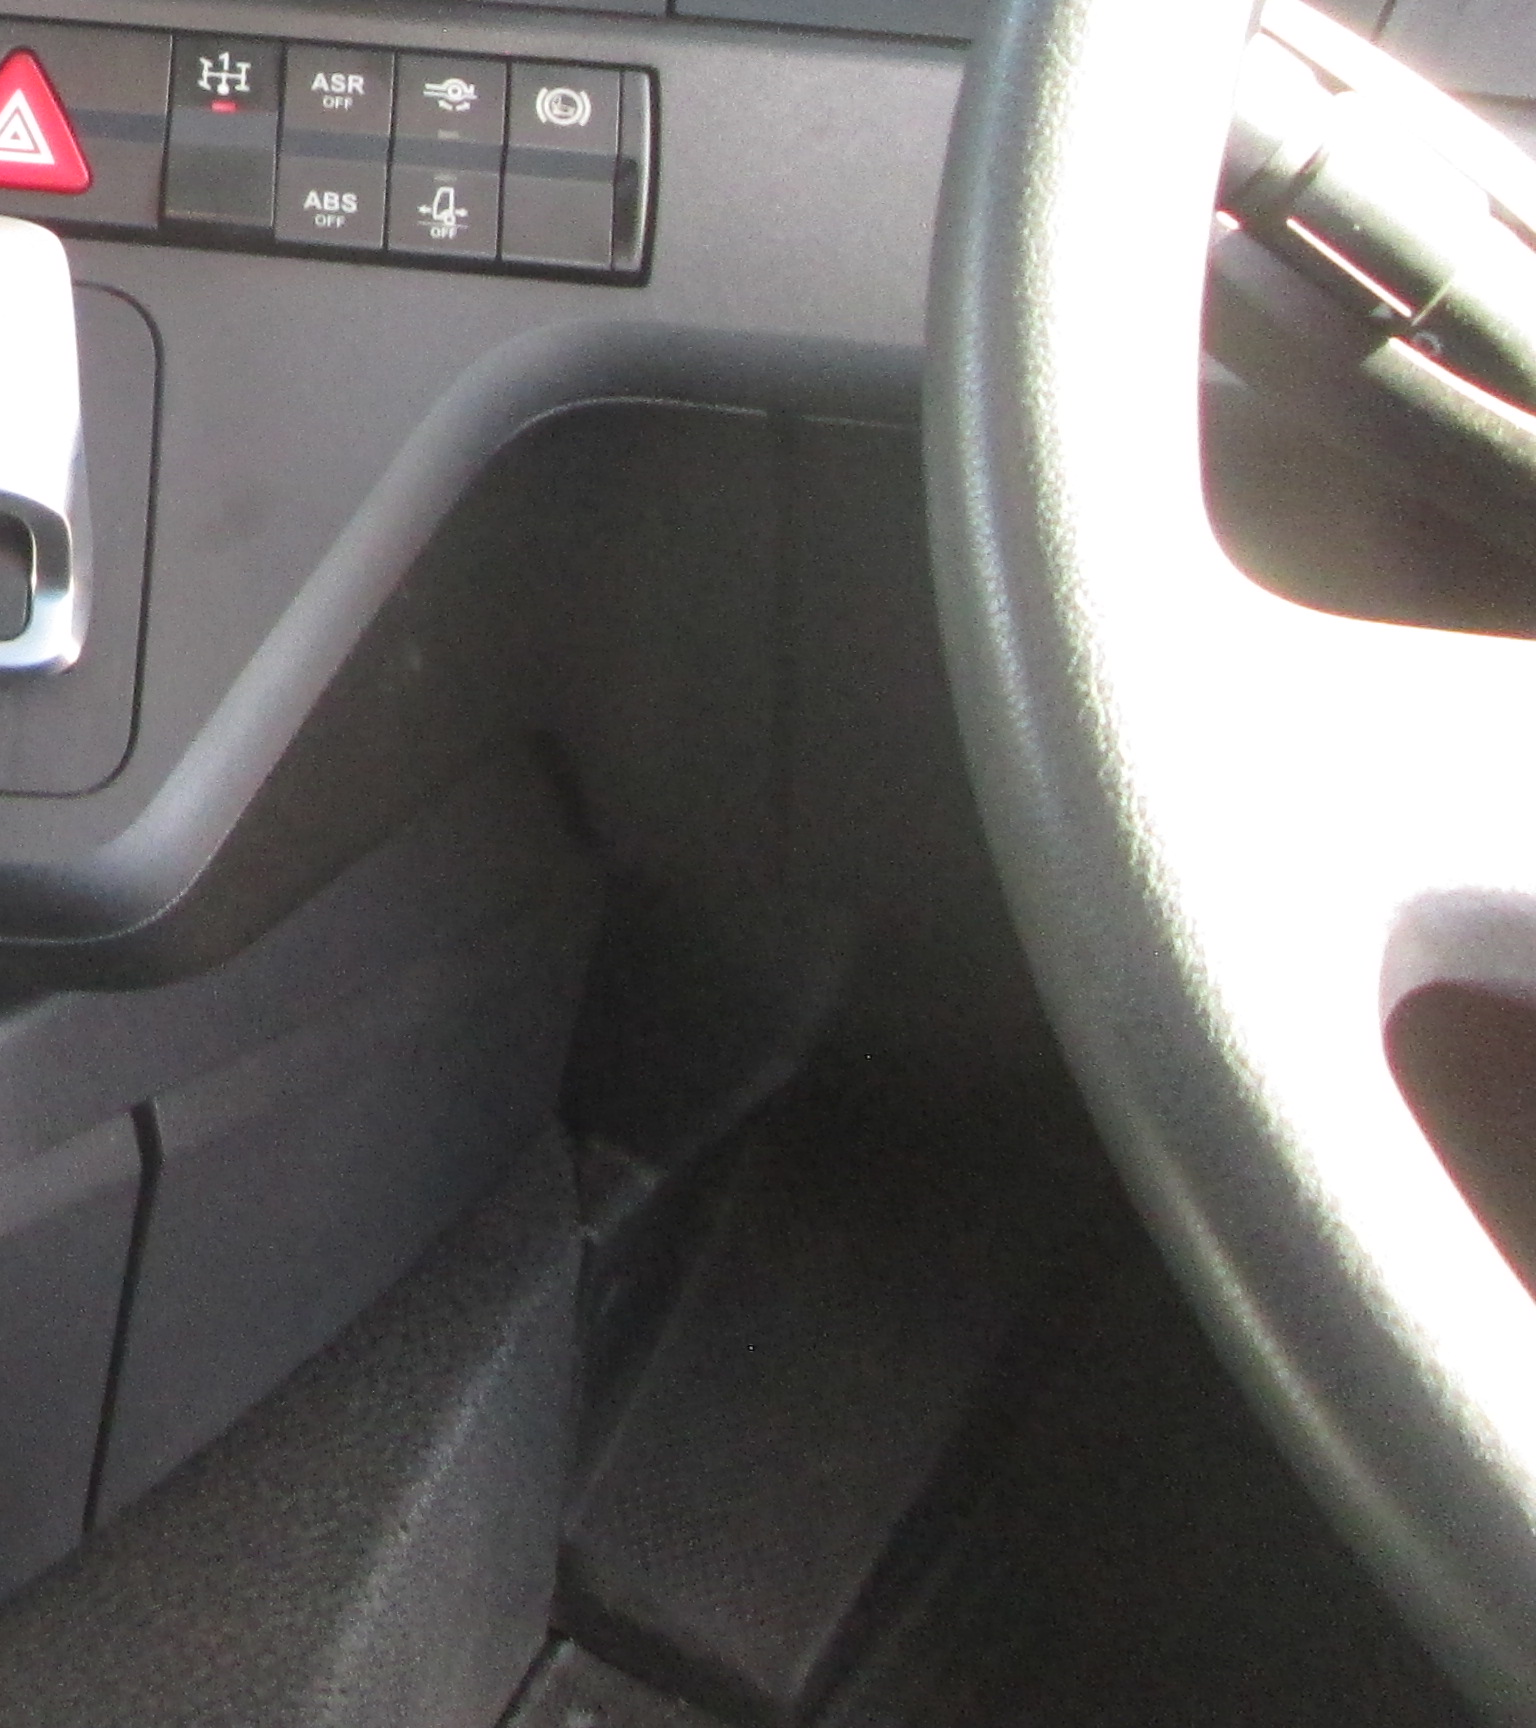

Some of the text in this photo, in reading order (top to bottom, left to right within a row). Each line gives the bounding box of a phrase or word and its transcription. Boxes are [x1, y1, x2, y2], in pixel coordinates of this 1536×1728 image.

[310, 72, 365, 96] ASR
[322, 95, 354, 111] OFF
[303, 190, 358, 214] ABS
[314, 213, 345, 229] OFF
[429, 226, 458, 240] OFF
